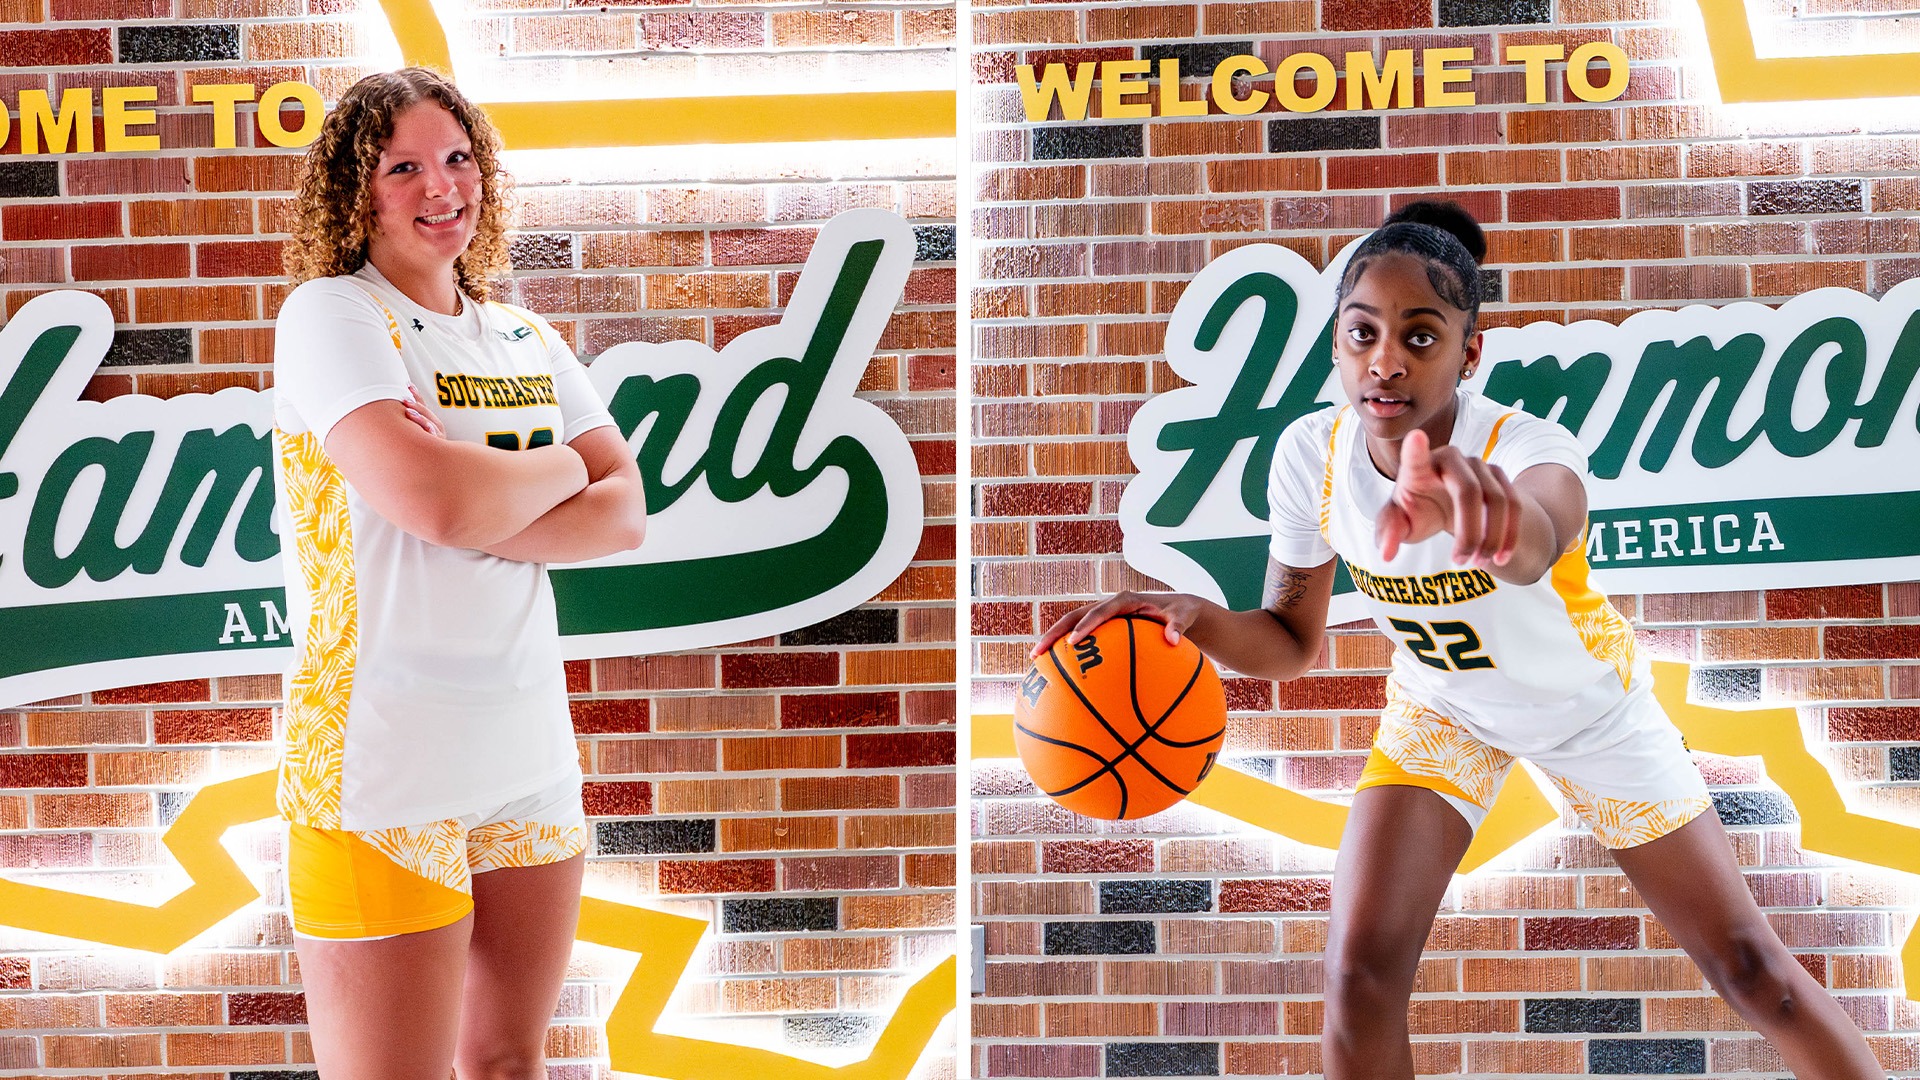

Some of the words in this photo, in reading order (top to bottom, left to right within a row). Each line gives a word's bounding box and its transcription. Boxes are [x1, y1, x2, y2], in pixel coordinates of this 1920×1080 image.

[0, 86, 161, 154] ME
[193, 81, 326, 149] TO
[1015, 46, 1476, 123] WELCOME
[1506, 41, 1630, 104] TO
[1386, 615, 1498, 673] 22
